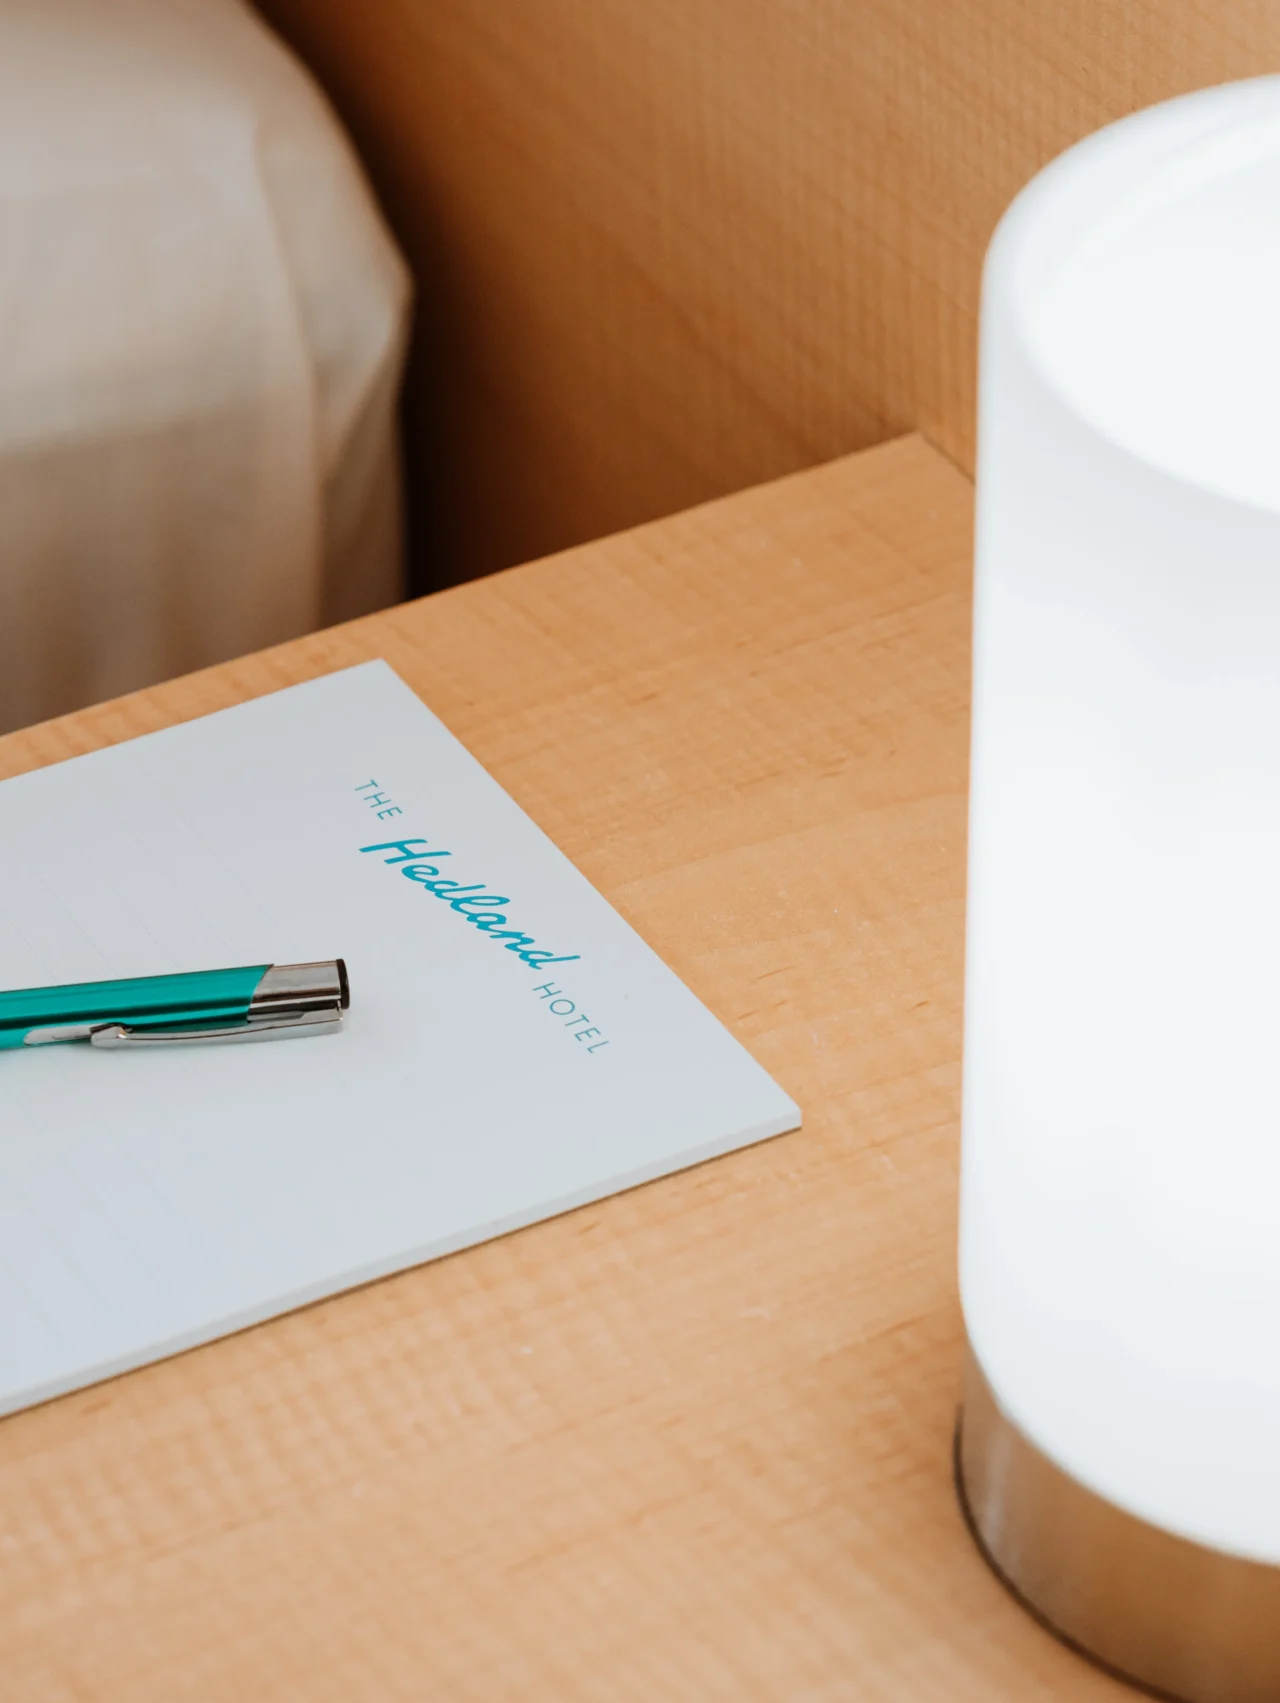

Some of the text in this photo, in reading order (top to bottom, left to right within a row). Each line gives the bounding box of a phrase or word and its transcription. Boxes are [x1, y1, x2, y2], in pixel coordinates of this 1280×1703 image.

[355, 779, 609, 1054] THE Hedland HOTEL
